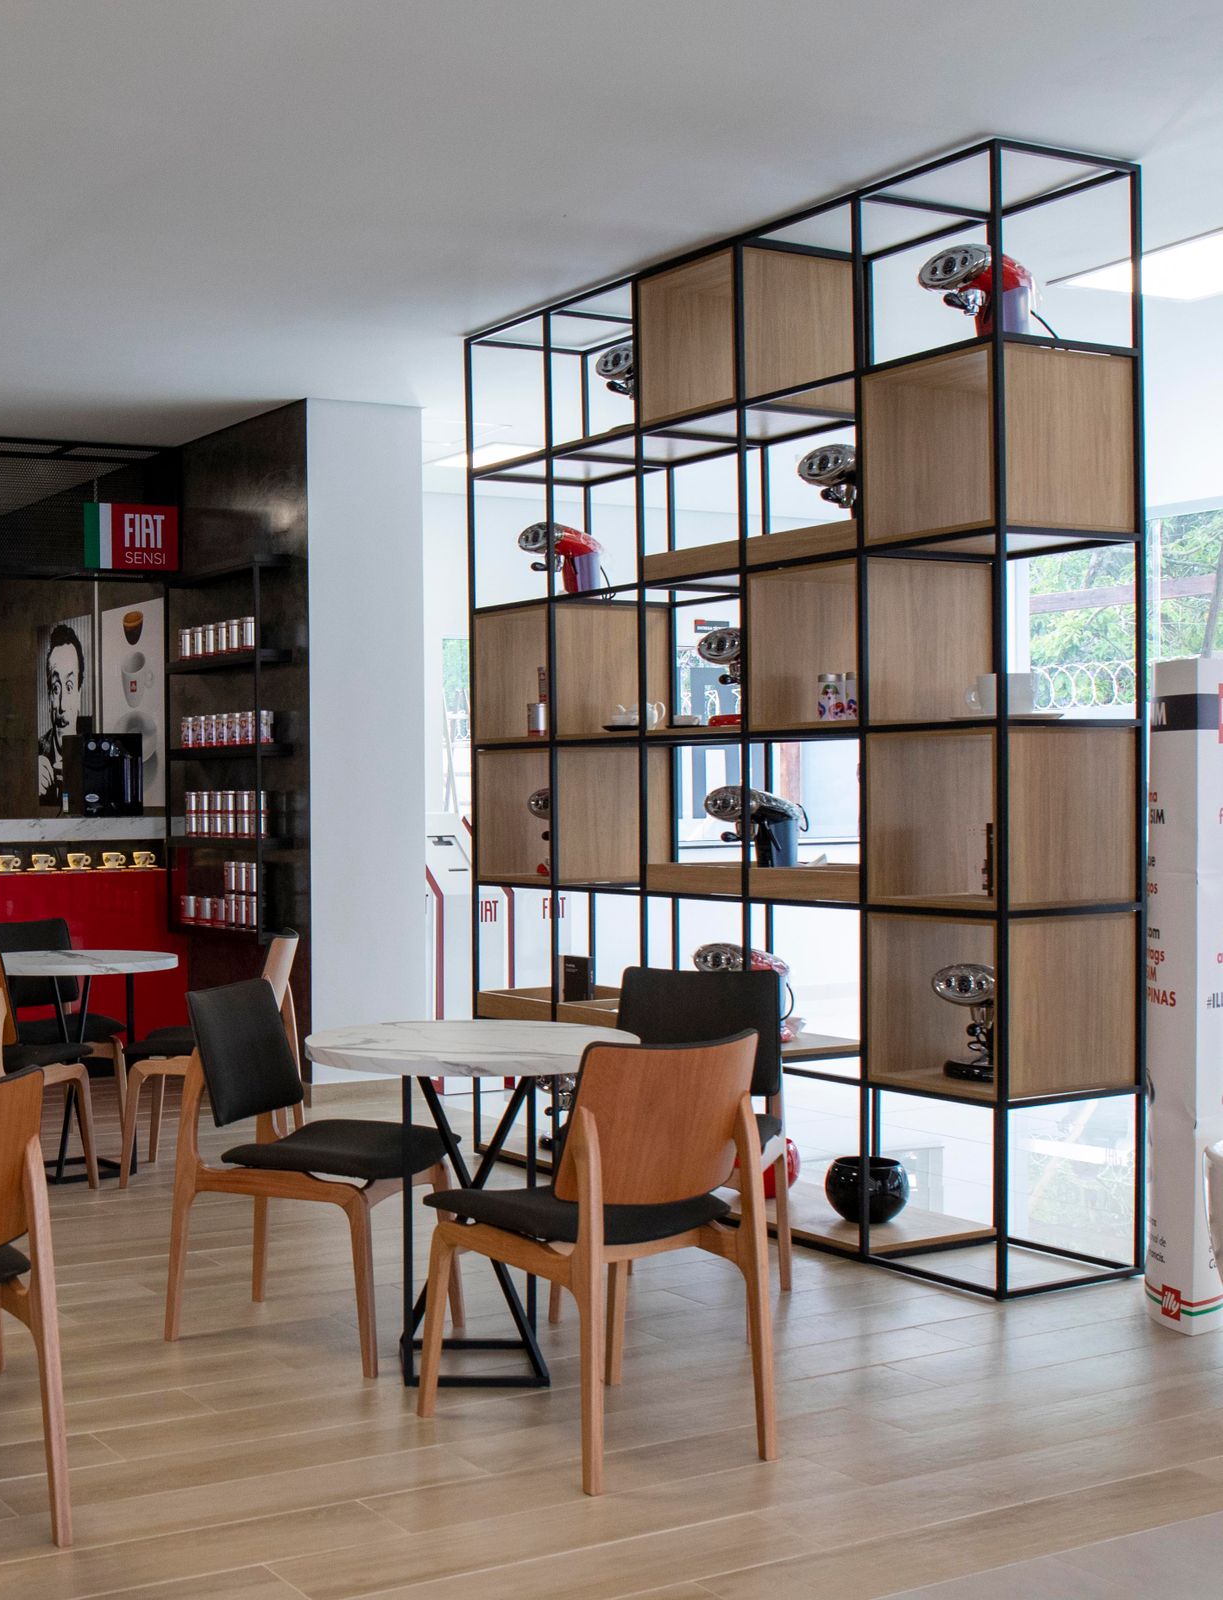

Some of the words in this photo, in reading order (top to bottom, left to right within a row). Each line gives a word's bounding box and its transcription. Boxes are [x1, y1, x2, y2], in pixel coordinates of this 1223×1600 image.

[124, 513, 165, 548] FIAT
[124, 551, 166, 565] SENSI
[480, 900, 499, 922] IAT
[1162, 1291, 1179, 1316] illy
